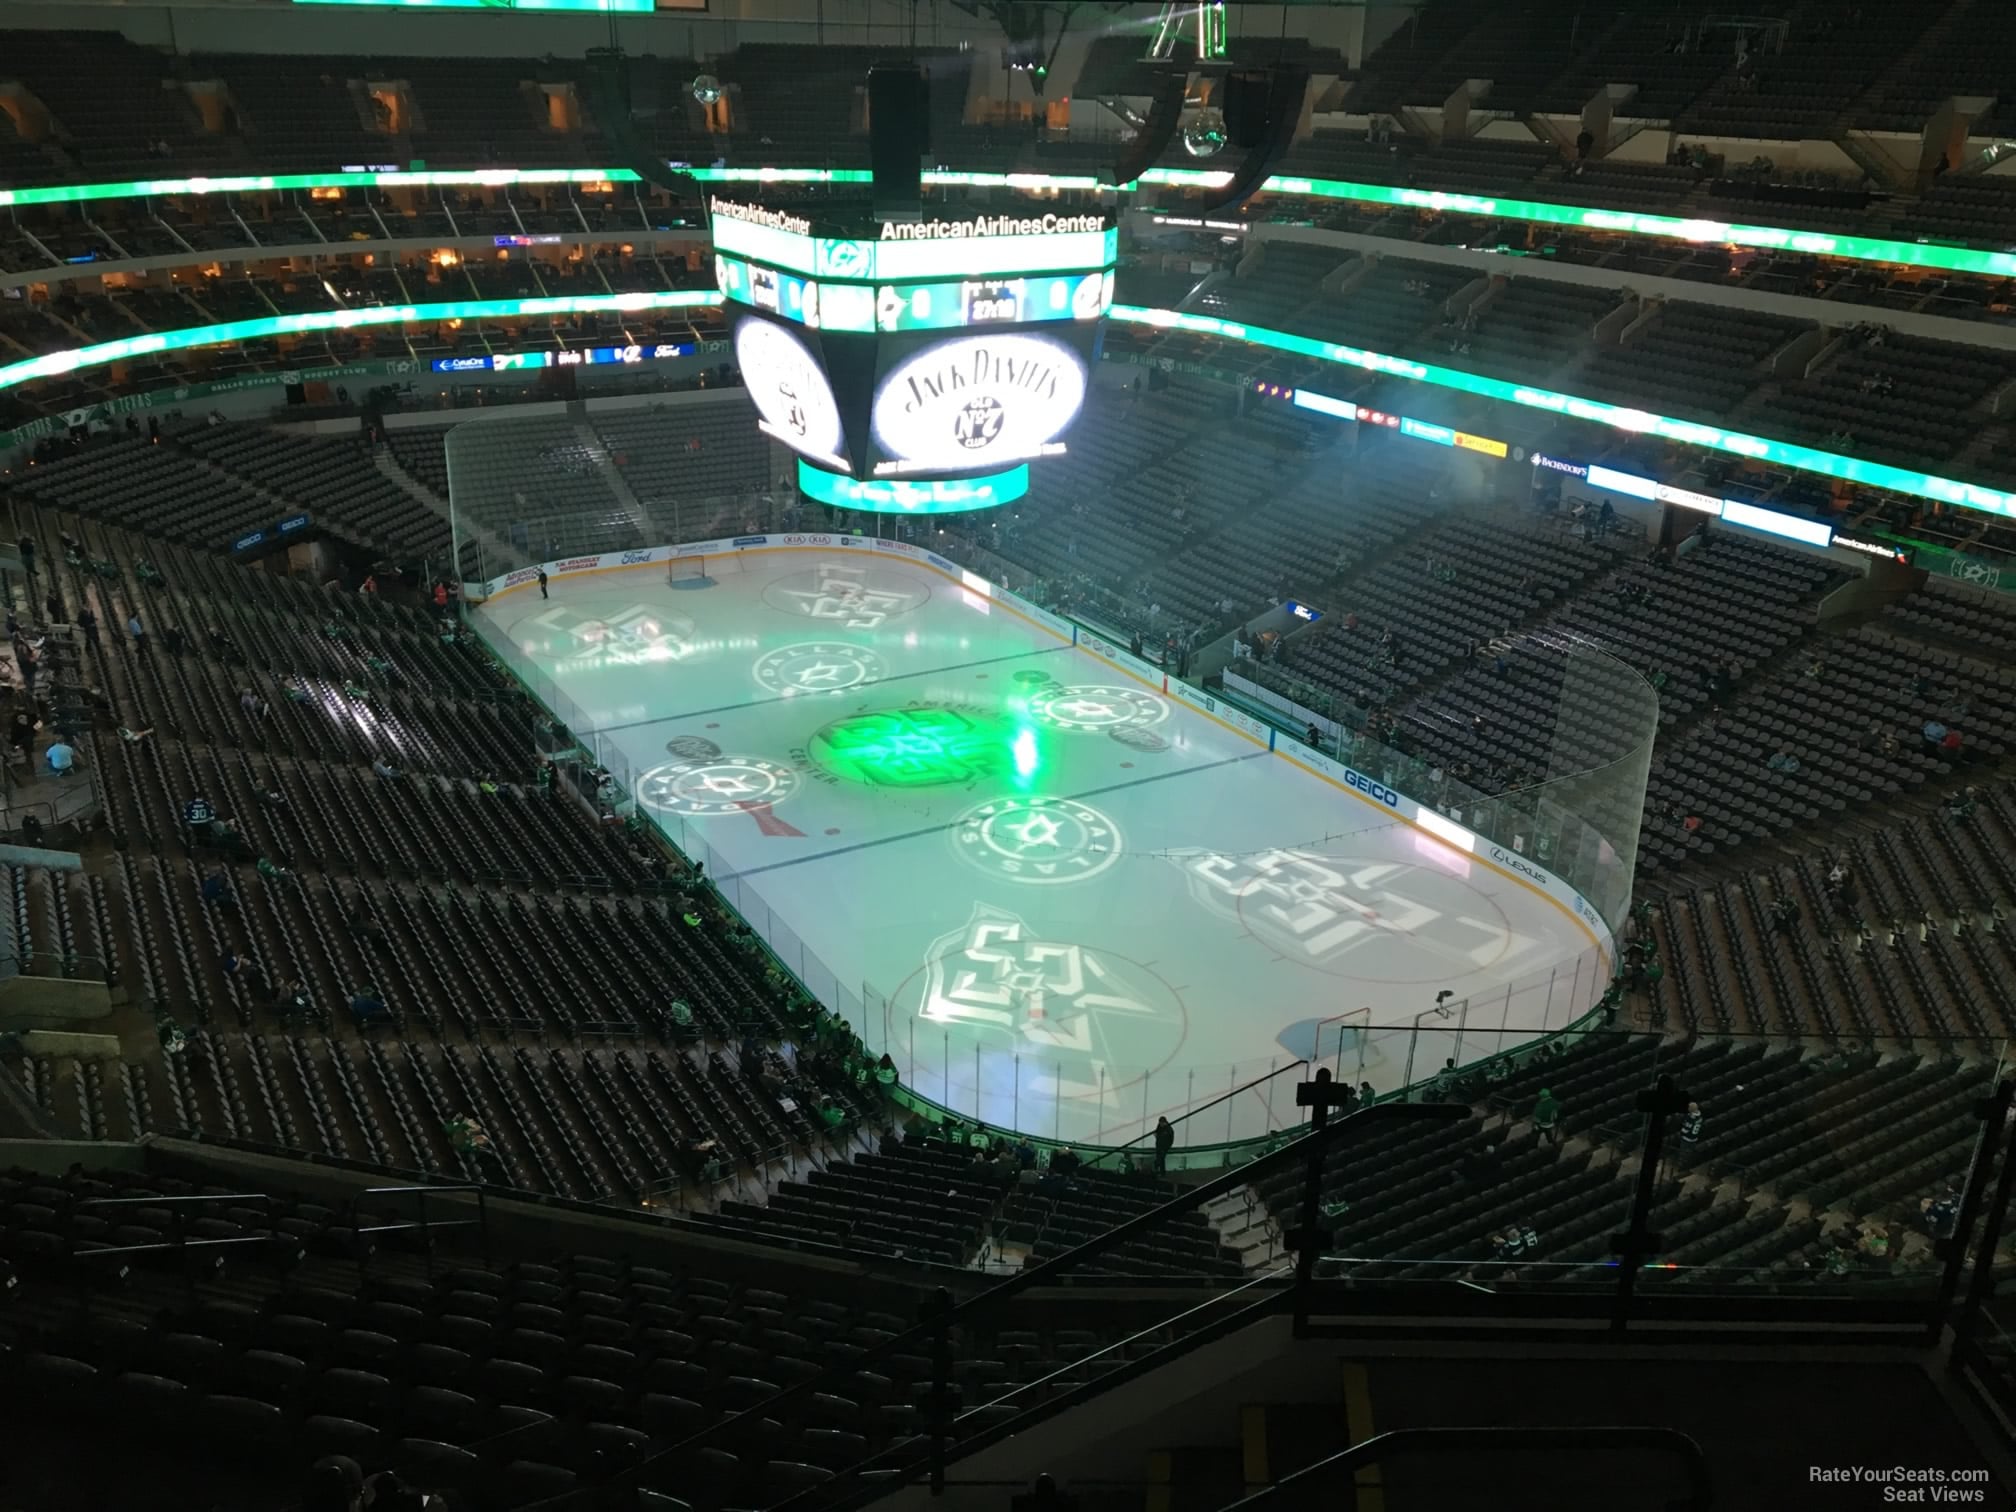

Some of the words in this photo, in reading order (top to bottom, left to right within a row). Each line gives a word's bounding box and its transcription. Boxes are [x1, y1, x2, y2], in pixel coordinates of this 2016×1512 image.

[654, 345, 681, 358] Ford
[119, 392, 152, 413] TEXAS
[282, 517, 304, 531] GEICO
[621, 550, 652, 565] Ford
[1344, 769, 1398, 808] GEICO
[1505, 856, 1547, 884] LEXUS
